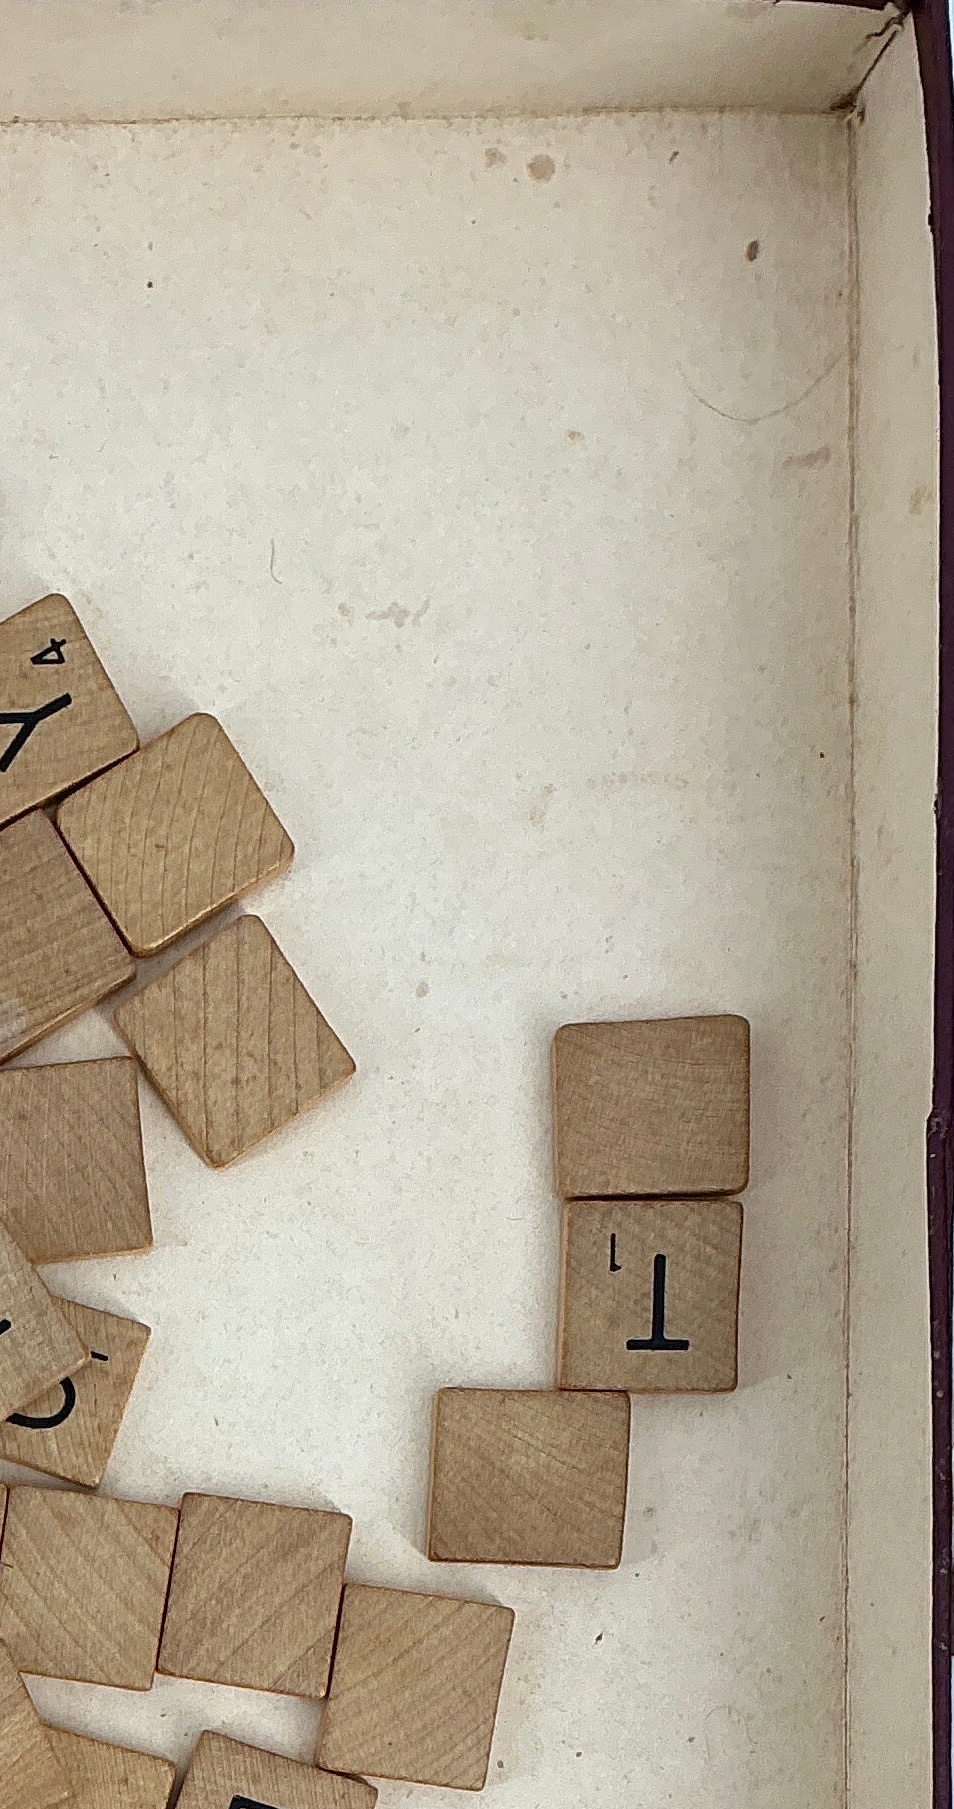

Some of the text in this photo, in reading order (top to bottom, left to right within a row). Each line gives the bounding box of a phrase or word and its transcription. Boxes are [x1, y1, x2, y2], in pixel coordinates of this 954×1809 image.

[29, 637, 68, 666] 4
[608, 1231, 691, 1352] T 1
